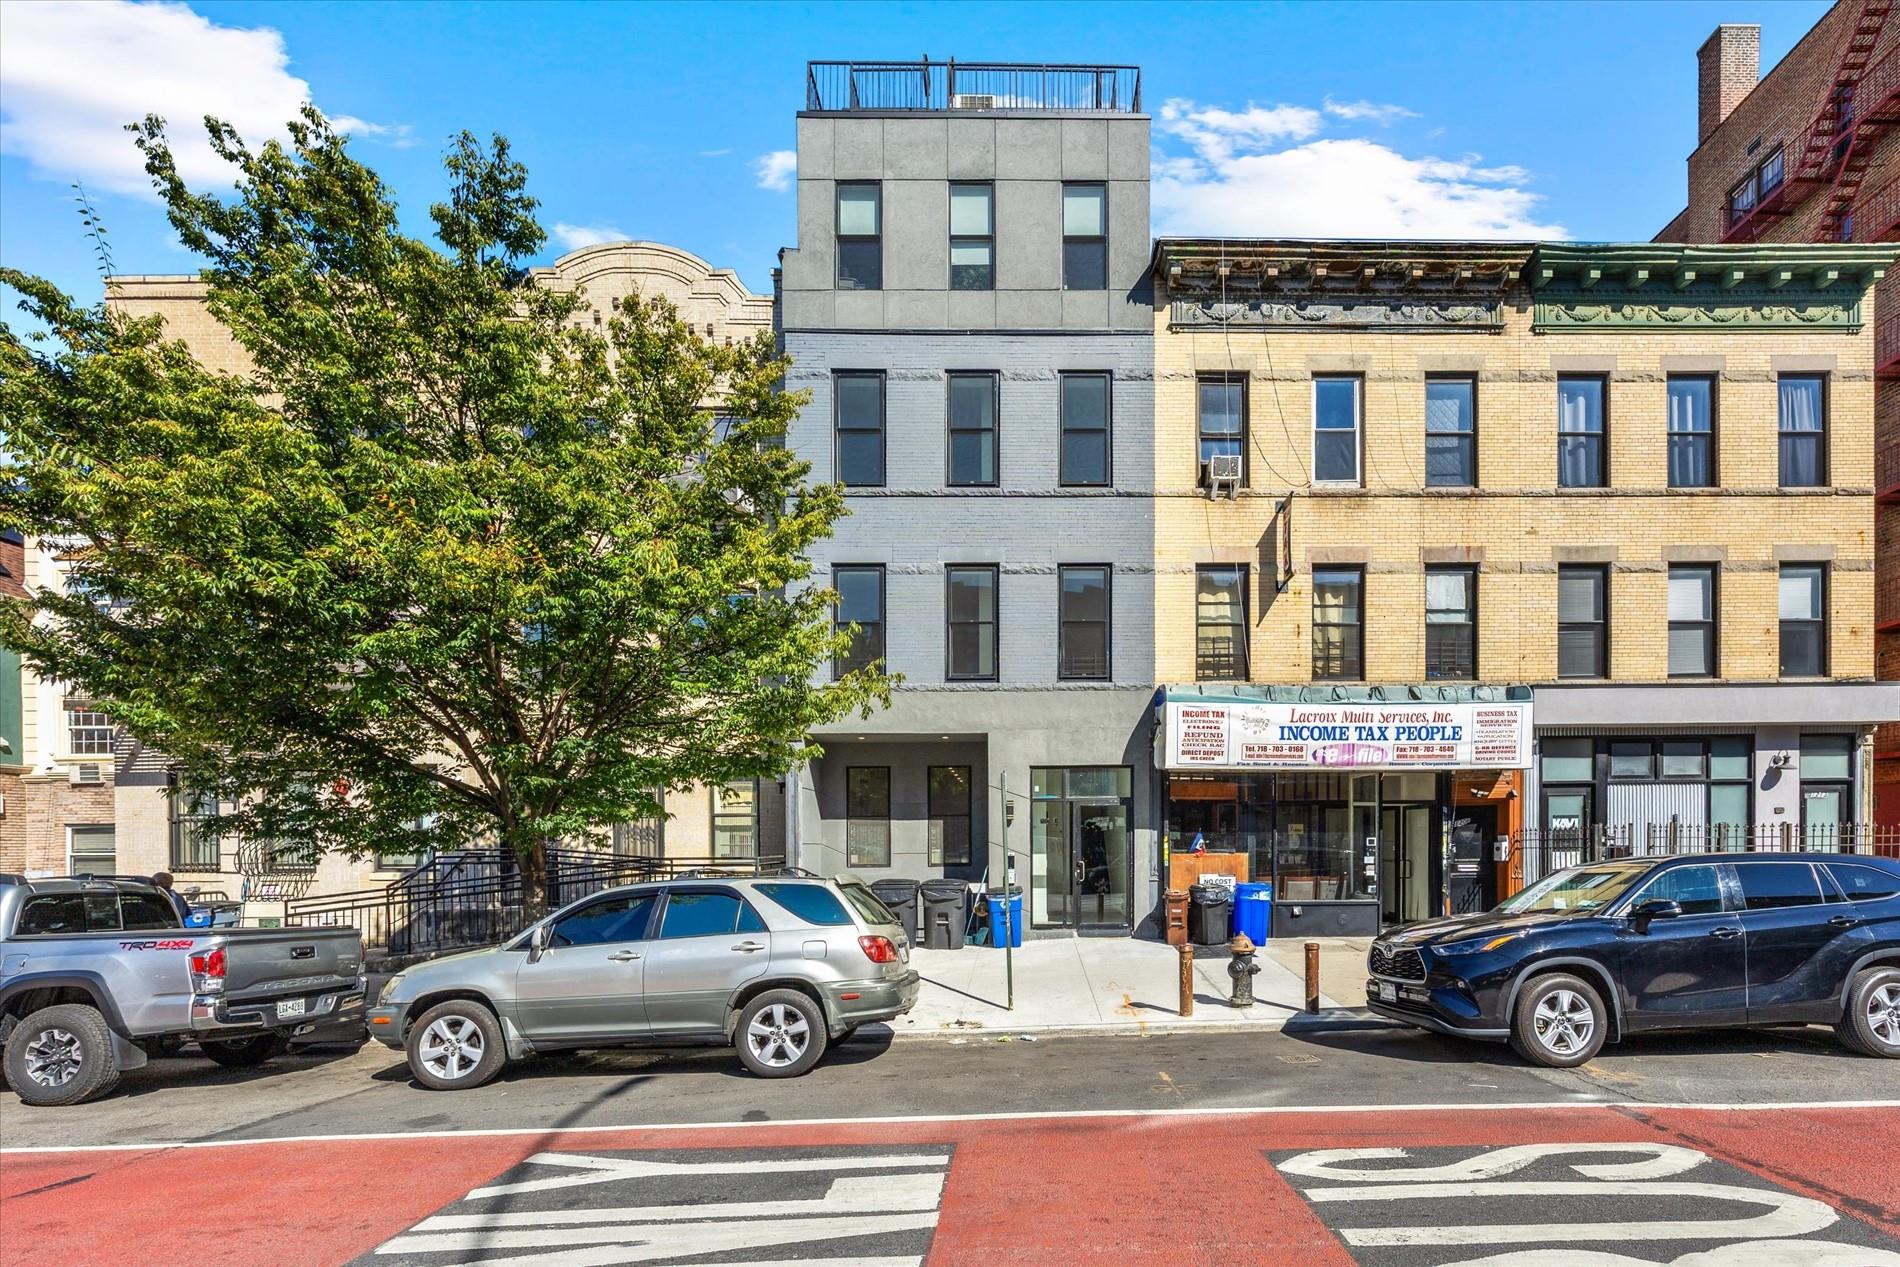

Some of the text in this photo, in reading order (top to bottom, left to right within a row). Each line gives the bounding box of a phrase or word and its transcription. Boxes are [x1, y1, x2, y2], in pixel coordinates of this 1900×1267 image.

[1182, 710, 1225, 718] INCOME TAX
[1432, 710, 1454, 723] Inc.
[1184, 731, 1224, 739] REFUND
[1279, 725, 1463, 741] INCOME TAX PEOPLE
[119, 941, 158, 951] TRD
[259, 974, 336, 990] TACOMA
